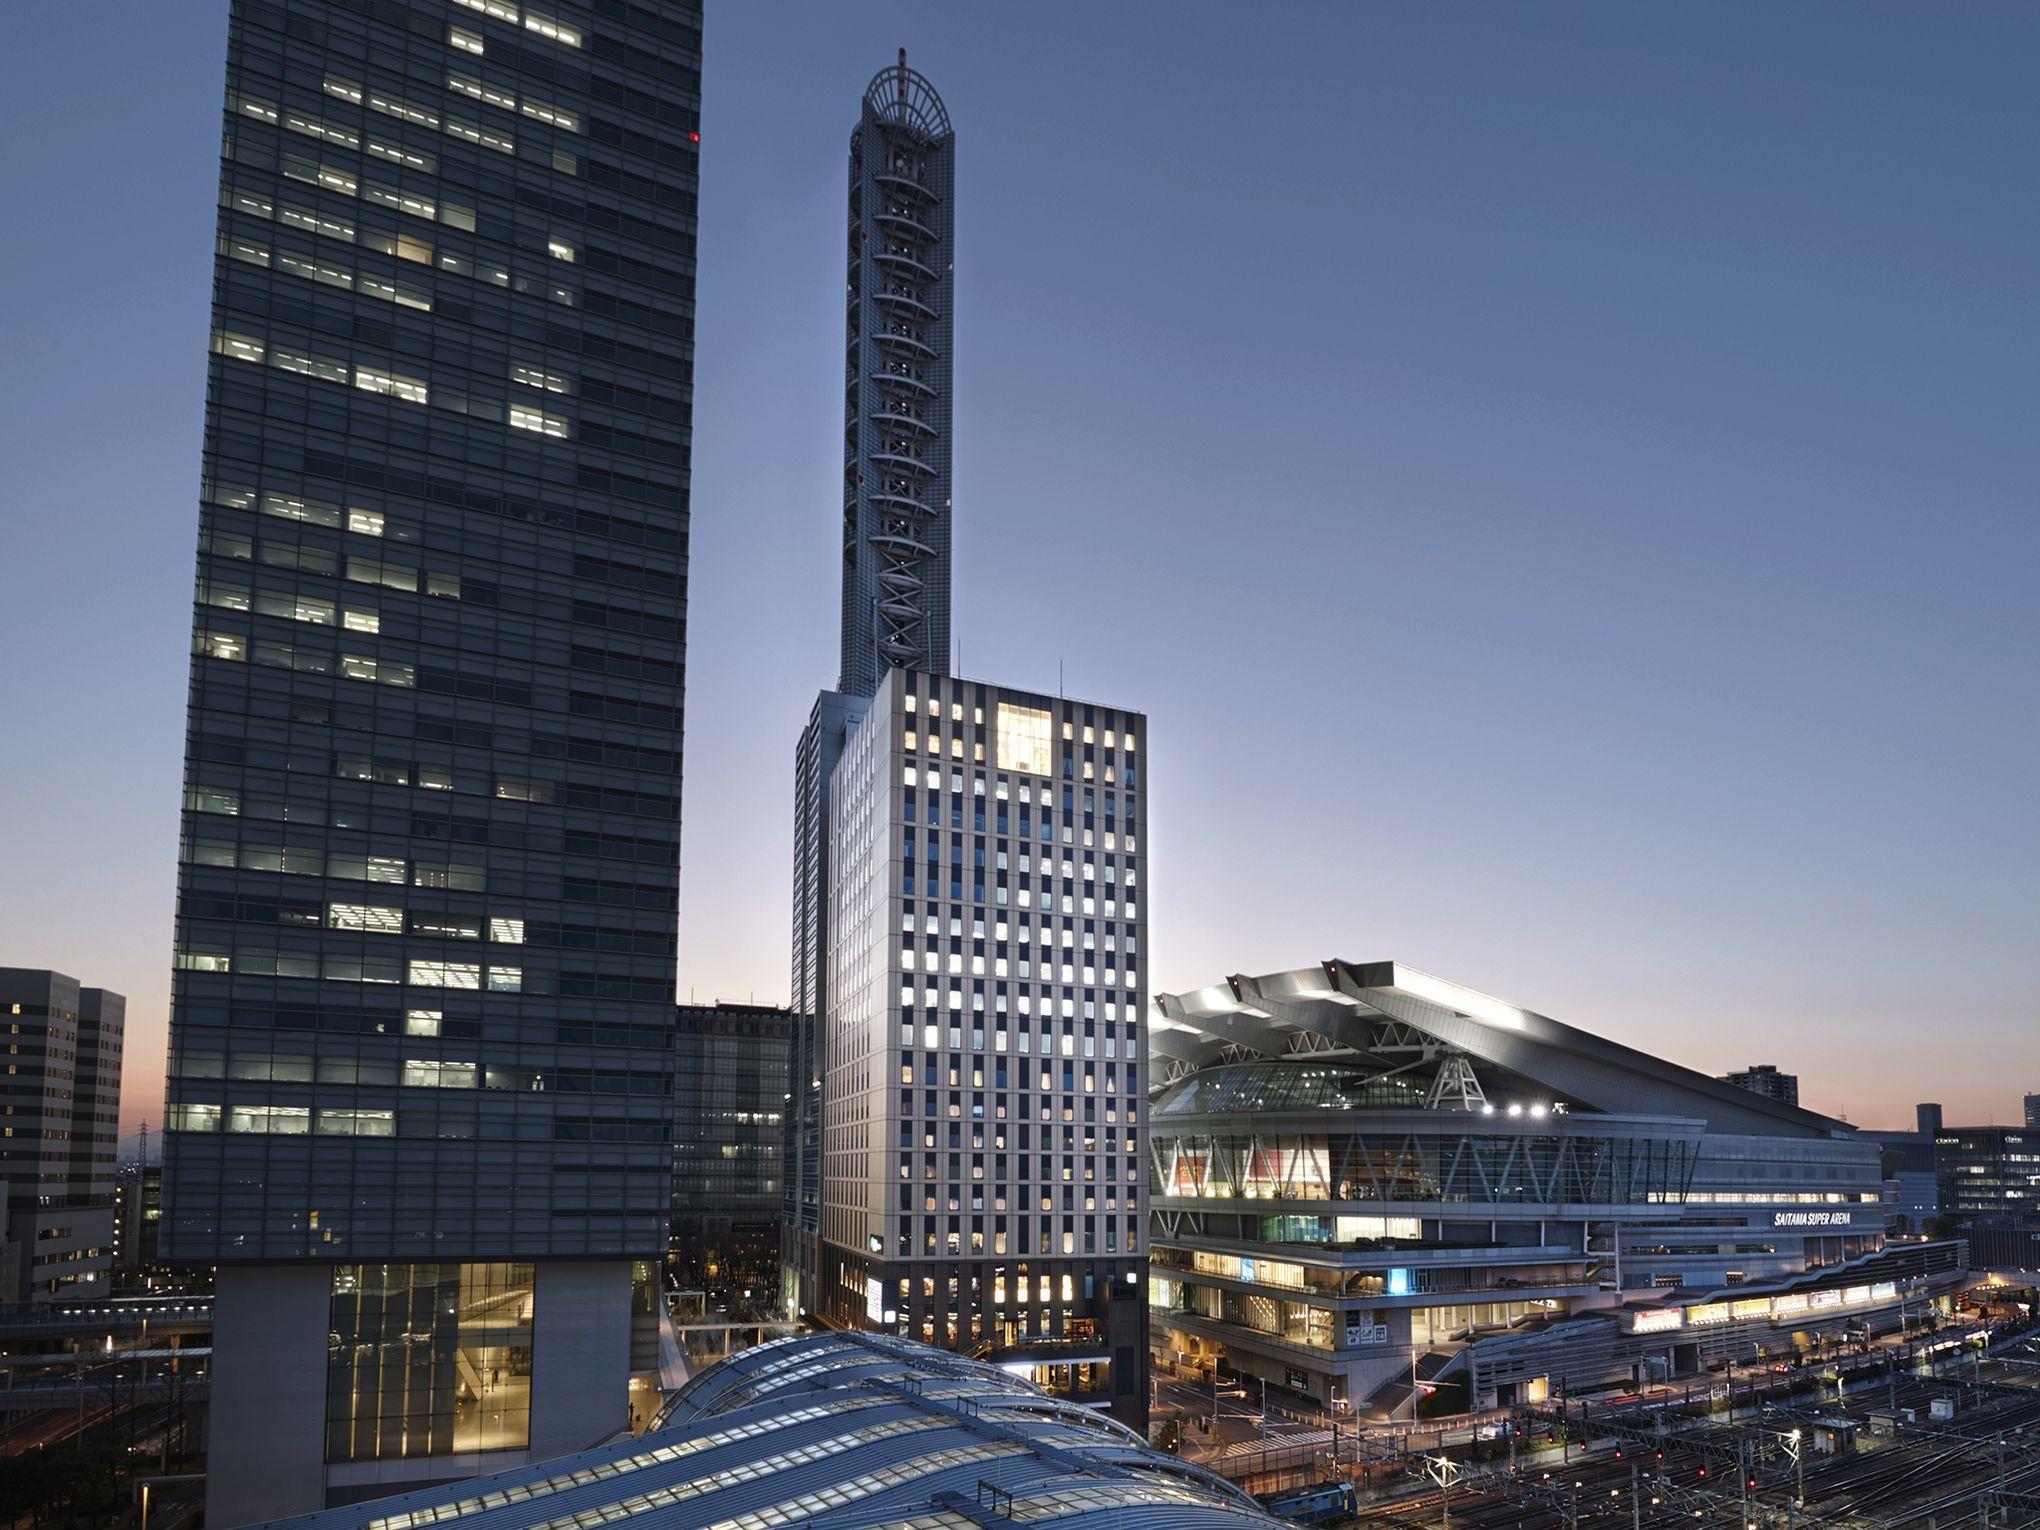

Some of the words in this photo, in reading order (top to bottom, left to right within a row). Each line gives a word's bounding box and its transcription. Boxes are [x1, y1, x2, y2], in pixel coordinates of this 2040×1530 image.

[1774, 1212, 1808, 1226] SAITAMA
[1807, 1212, 1831, 1226] SUPER
[1830, 1212, 1851, 1225] ARENA
